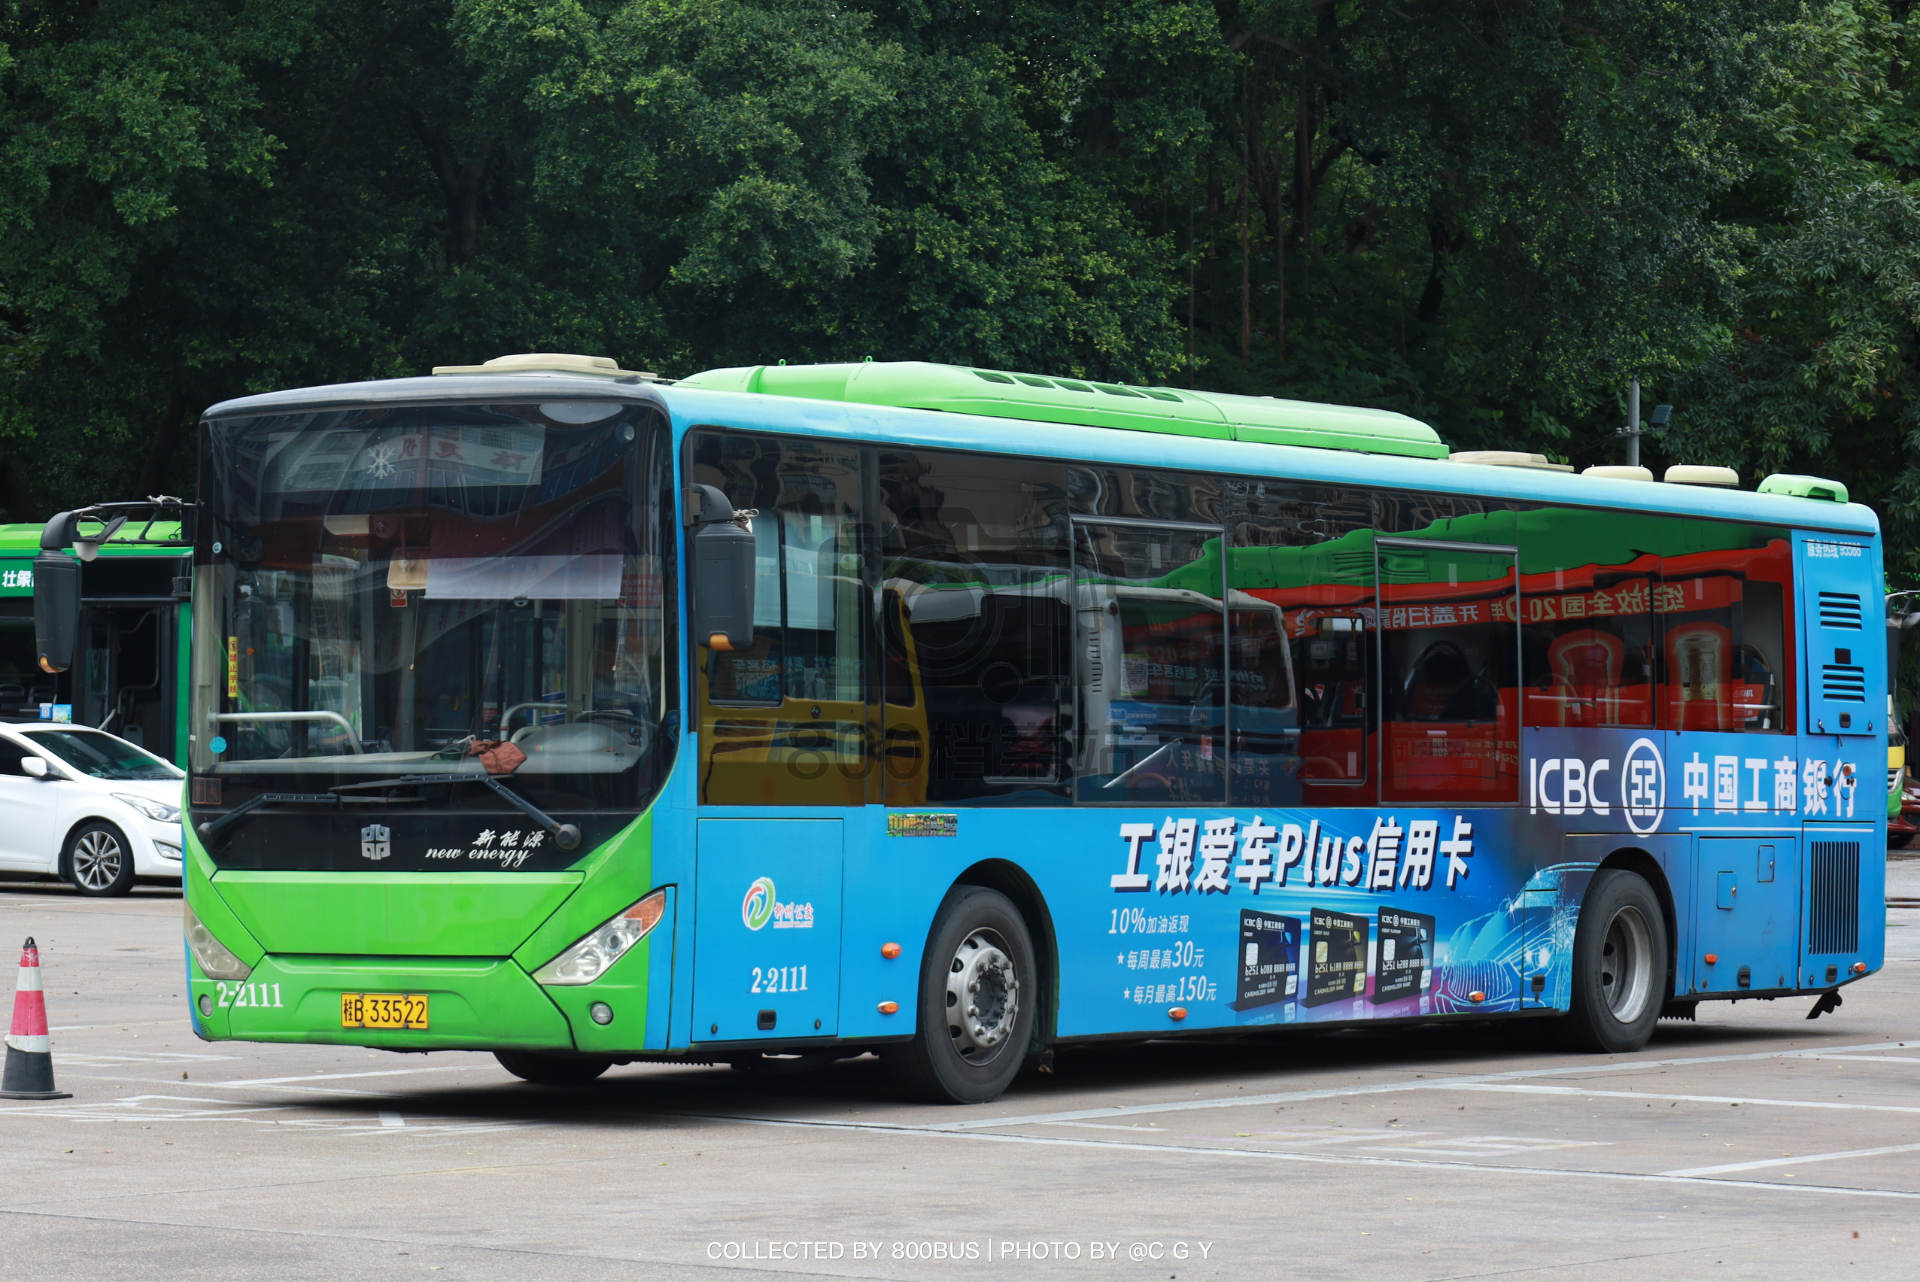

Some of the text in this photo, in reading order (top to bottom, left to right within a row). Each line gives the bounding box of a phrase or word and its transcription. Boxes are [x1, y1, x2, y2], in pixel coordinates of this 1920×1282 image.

[2, 570, 34, 588] 壮象
[1530, 758, 1609, 815] ICBC
[1683, 752, 1857, 818] 中国工商银行
[472, 829, 545, 848] 新能源
[425, 847, 533, 867] new energy
[1110, 815, 1474, 894] 工银爱车Plus信用卡
[1108, 907, 1190, 934] 10%加油返现
[1244, 918, 1256, 928] ICBC
[1313, 917, 1325, 926] ICBC
[1381, 915, 1393, 924] ICBC
[1127, 940, 1205, 970] 每周最高30元
[751, 965, 808, 993] 2-2111
[1133, 975, 1217, 1004] 每月最高150元
[216, 981, 283, 1008] 2-2111
